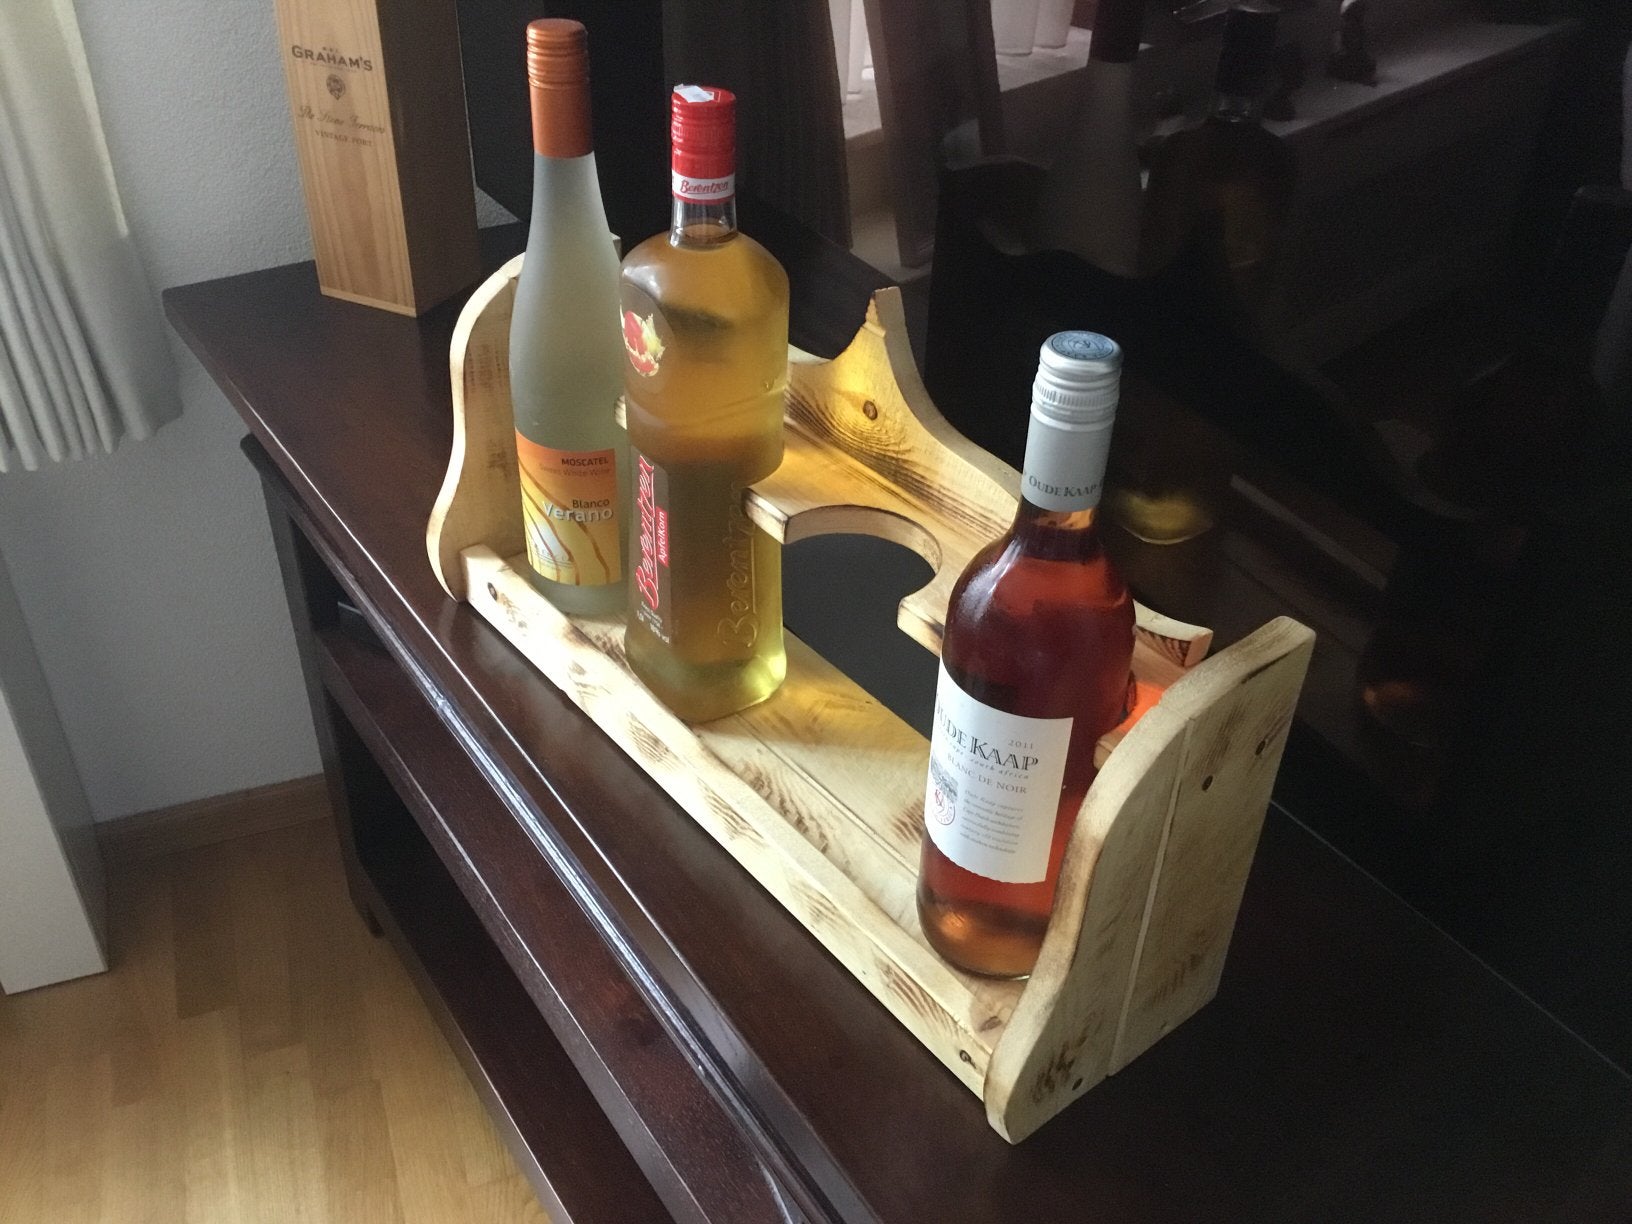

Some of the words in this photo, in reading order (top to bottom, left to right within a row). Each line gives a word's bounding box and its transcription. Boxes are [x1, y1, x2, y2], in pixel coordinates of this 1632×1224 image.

[291, 44, 373, 72] GRAHAM'S
[314, 128, 348, 143] VINTAGE
[680, 179, 729, 195] Berentzen
[561, 456, 609, 467] MOSCATEL
[1028, 475, 1061, 497] OUDE
[1063, 483, 1098, 498] KAAP
[543, 501, 614, 523] Verano
[572, 499, 610, 509] Blanco
[635, 454, 660, 611] Berentzen
[657, 511, 666, 563] ApfelKorn
[970, 735, 1039, 771] KAAP
[1007, 739, 1034, 750] 2011
[947, 751, 974, 777] BLANC
[978, 774, 992, 785] DE
[996, 781, 1028, 794] NOIR
